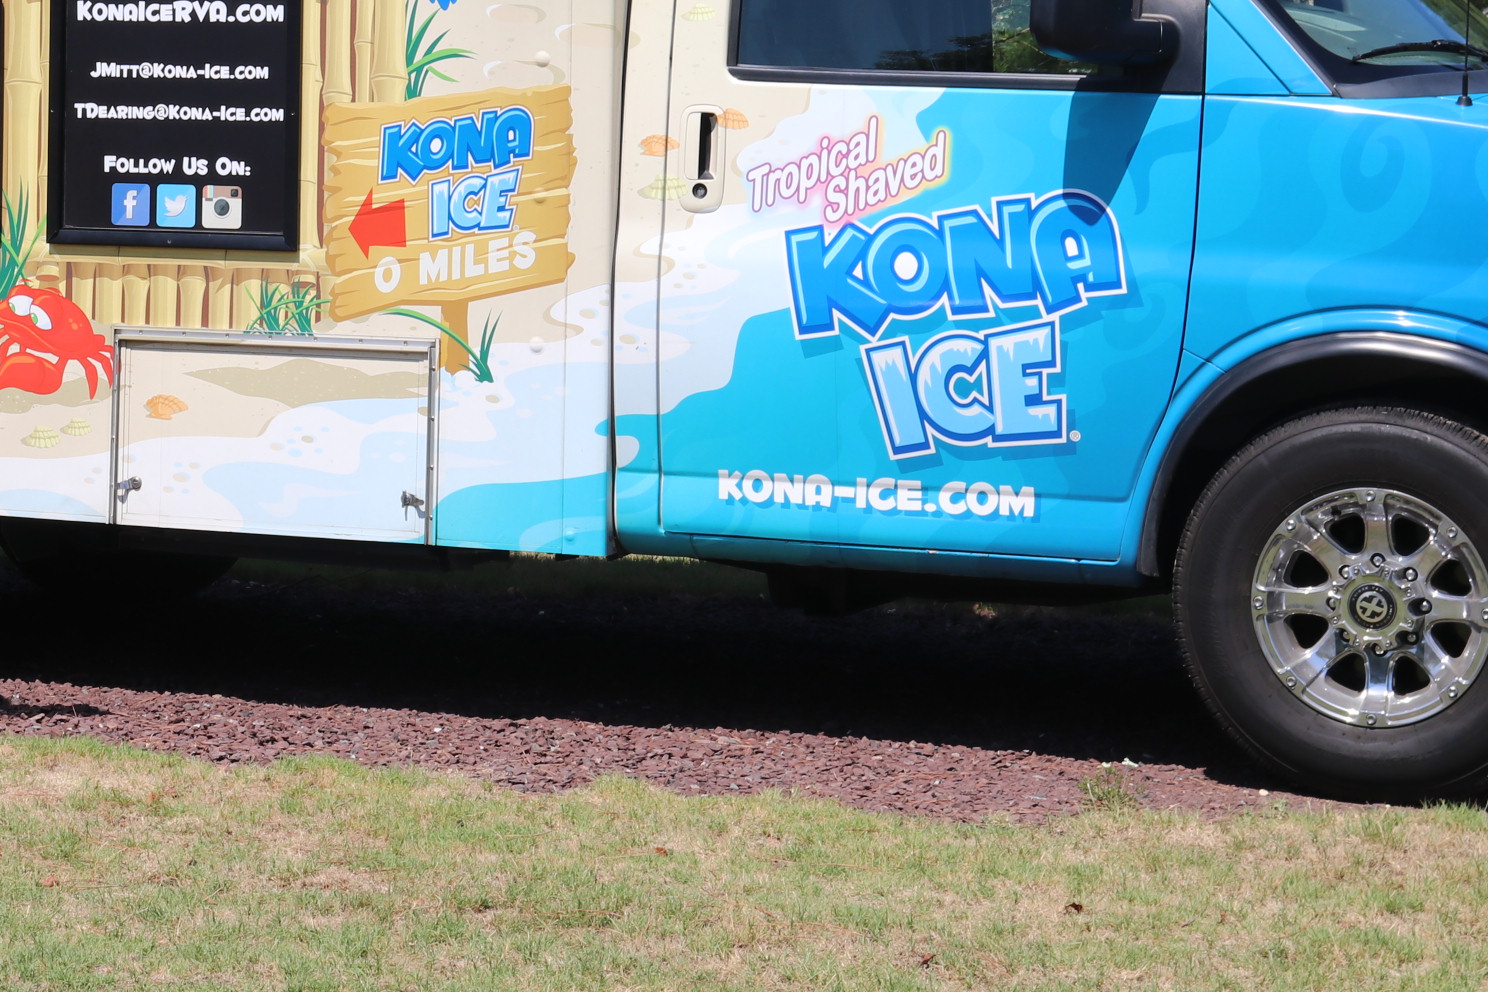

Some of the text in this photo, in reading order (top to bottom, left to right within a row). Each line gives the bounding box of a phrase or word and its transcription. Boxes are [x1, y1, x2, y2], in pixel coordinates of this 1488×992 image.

[103, 155, 251, 176] FOLLOW US ON:
[378, 105, 535, 185] KONA
[747, 115, 879, 213] Tropical
[824, 130, 948, 224] Shaved
[428, 165, 523, 243] ICE
[419, 231, 537, 285] MILES
[784, 188, 1128, 343] KONA
[859, 315, 1068, 461] ICE
[717, 469, 1035, 518] KONA-ICE.COM
